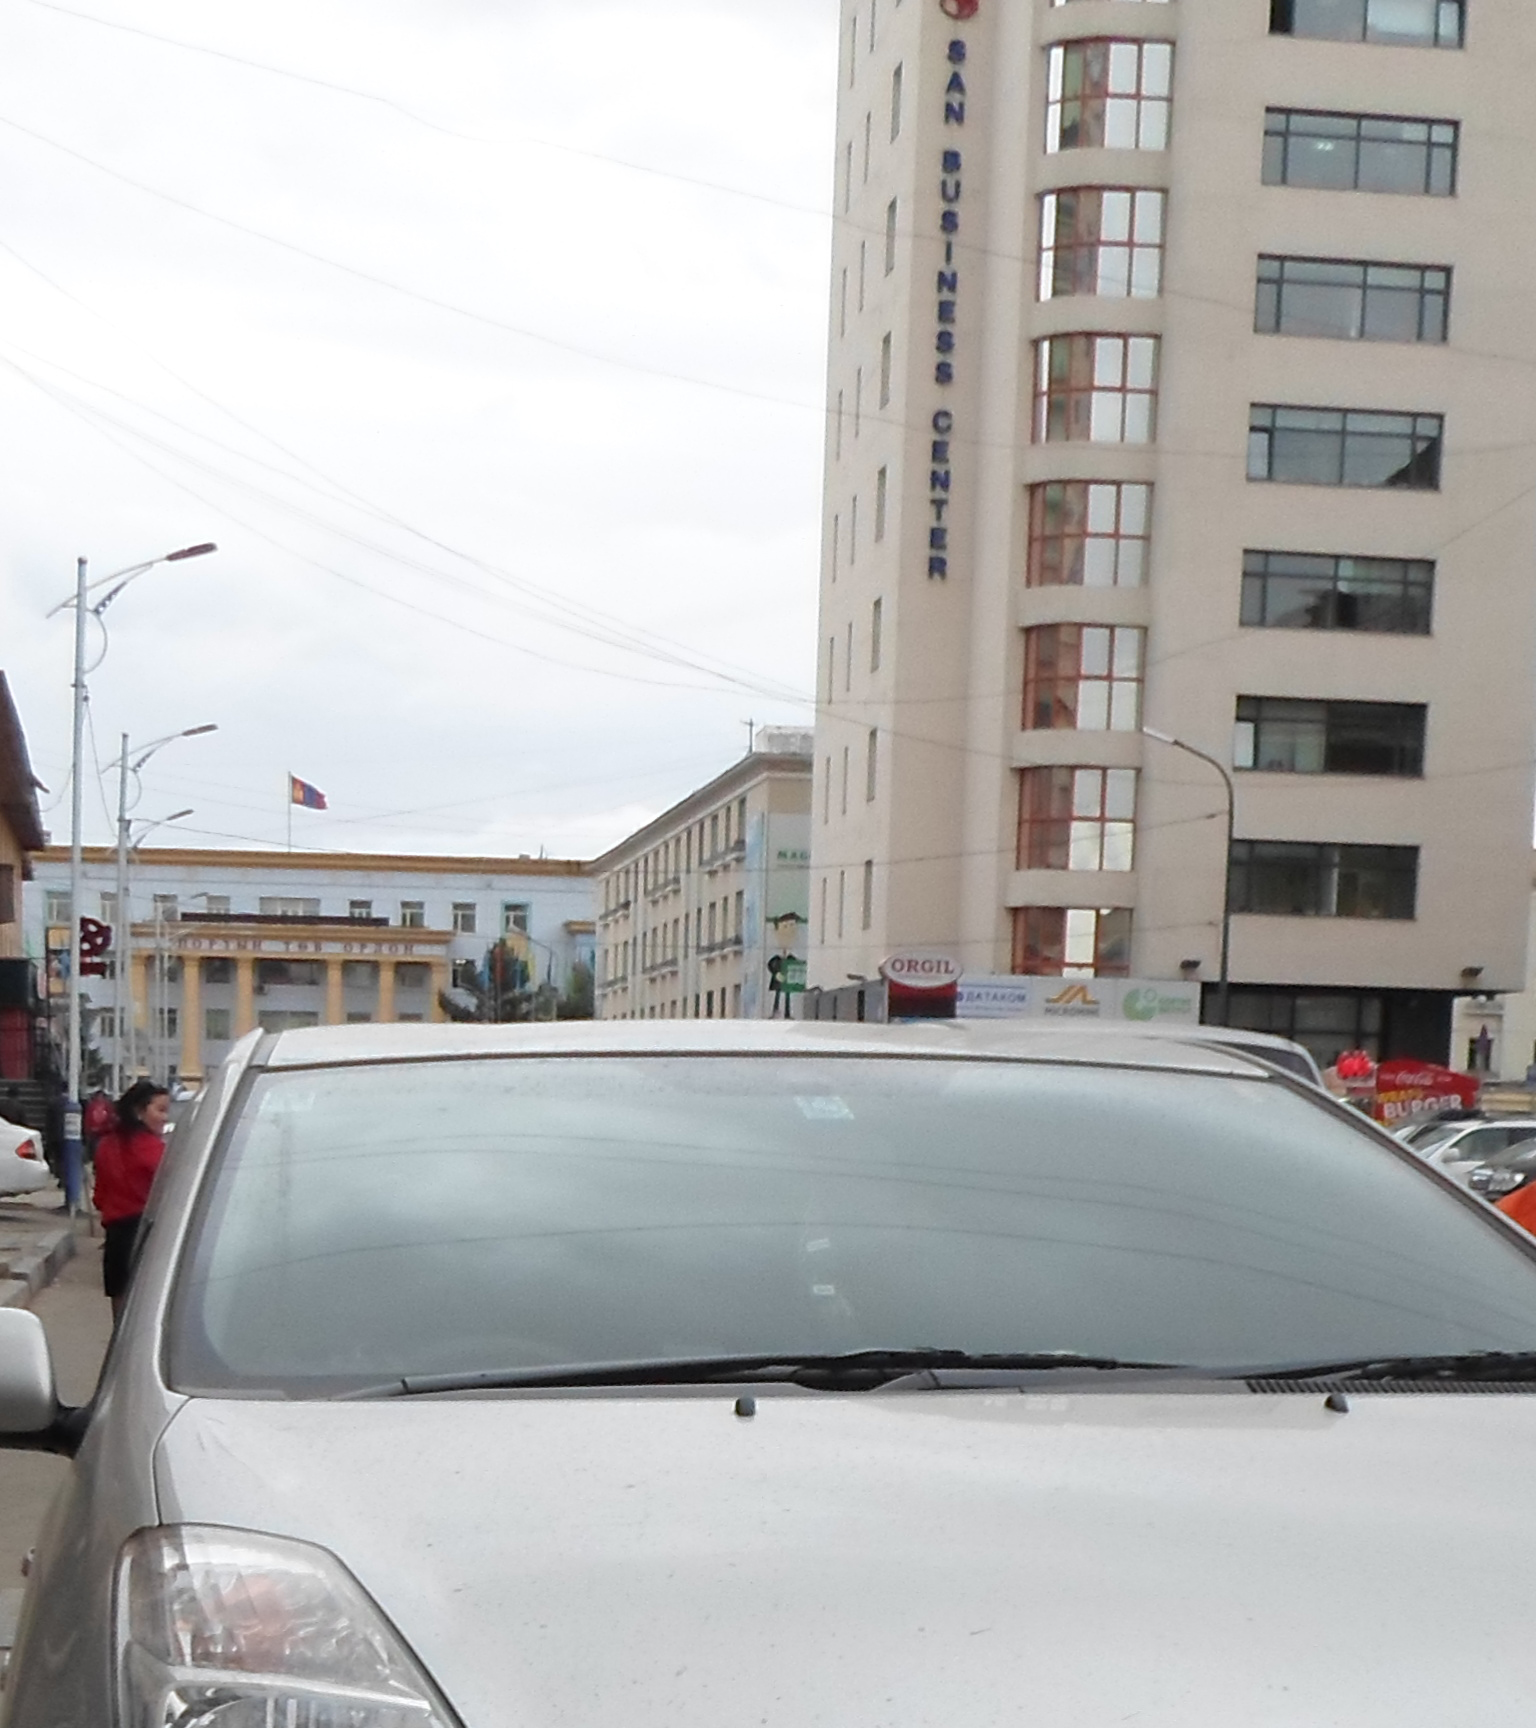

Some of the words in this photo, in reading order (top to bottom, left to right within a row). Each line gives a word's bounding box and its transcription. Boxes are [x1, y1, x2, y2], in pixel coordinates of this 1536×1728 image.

[944, 39, 966, 126] SAN
[935, 149, 962, 387] BUSINESS
[928, 409, 954, 580] CENTER
[173, 937, 263, 952] ПОРТЫН
[343, 943, 416, 955] ОРДОН
[891, 958, 955, 975] ORGIL
[965, 990, 1027, 1004] ДАТАКОМ
[1383, 1093, 1463, 1119] BURGER
